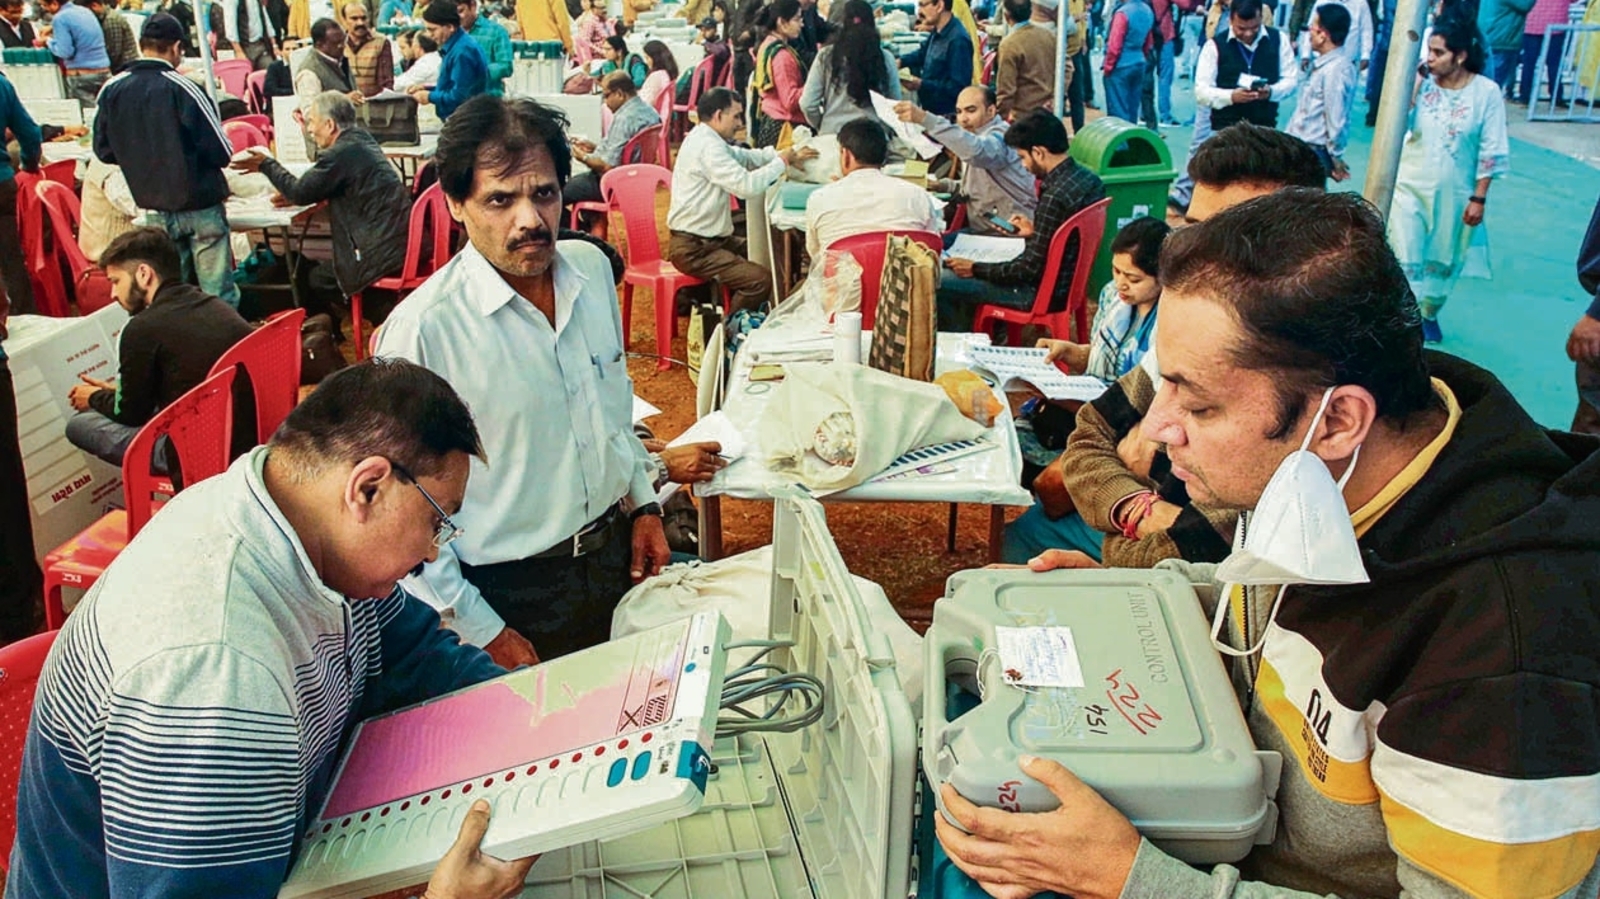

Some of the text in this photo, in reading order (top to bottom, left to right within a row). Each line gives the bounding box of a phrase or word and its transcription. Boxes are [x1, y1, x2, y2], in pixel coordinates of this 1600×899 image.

[1127, 591, 1169, 684] CONTROL UNIT
[1084, 704, 1109, 735] 154
[1306, 688, 1332, 746] 04
